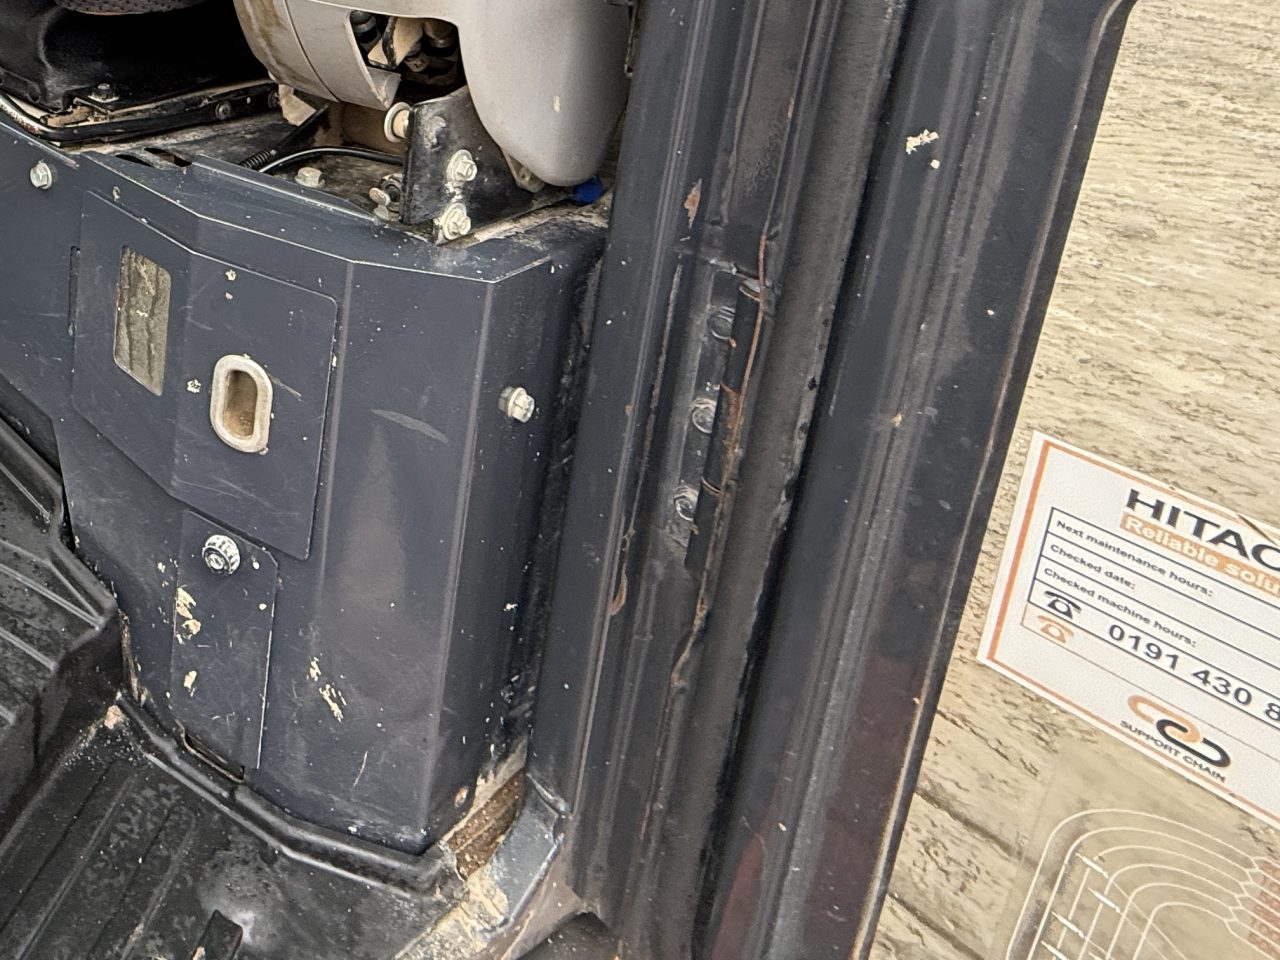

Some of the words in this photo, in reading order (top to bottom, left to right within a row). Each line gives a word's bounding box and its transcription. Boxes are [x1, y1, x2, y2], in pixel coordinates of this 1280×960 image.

[1050, 544, 1102, 573] Checked
[1104, 570, 1136, 590] date:
[1056, 520, 1084, 540] Next
[1086, 534, 1166, 576] maintenance
[1169, 570, 1213, 598] hours:
[1125, 516, 1219, 568] Reliable
[1044, 568, 1095, 597] Checked
[1098, 594, 1150, 625] machine
[1153, 621, 1196, 648] hours:
[1108, 624, 1180, 671] 0191
[1191, 670, 1252, 706] 430
[1120, 720, 1180, 757] SUPPORT
[1183, 755, 1226, 783] CHAIN
